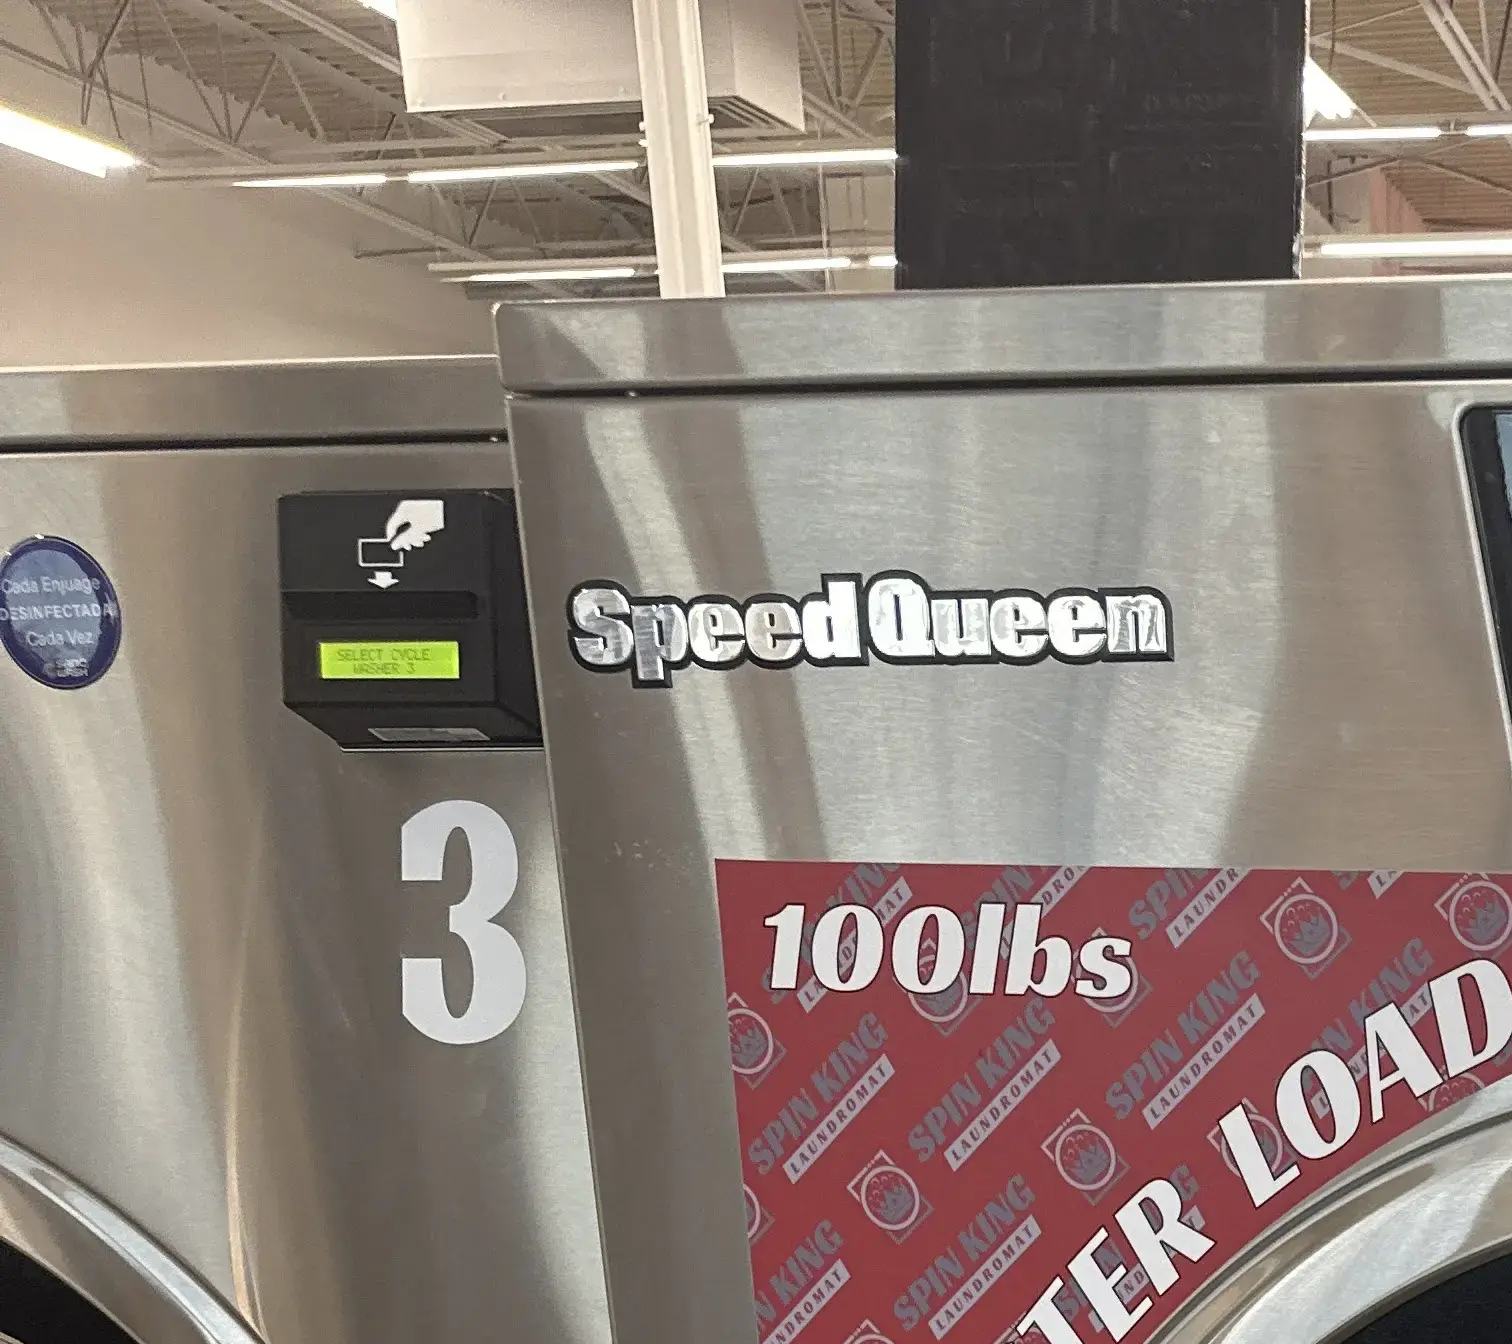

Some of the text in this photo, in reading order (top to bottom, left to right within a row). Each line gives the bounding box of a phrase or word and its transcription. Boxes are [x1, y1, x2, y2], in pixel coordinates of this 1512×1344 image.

[1, 576, 39, 595] Cada
[26, 628, 95, 647] Cada Vez
[337, 648, 431, 661] SELECT CYCLE
[353, 662, 416, 675] WASHER 3
[401, 799, 527, 1045] 3
[763, 902, 1132, 999] 100lbs
[908, 1072, 982, 1163] SPIN
[975, 997, 1055, 1090] KING
[1106, 1028, 1183, 1121] SPIN
[1177, 950, 1260, 1045] KING
[1149, 1003, 1256, 1120] LAUNDROMAT
[748, 1087, 819, 1175] SPIN
[810, 1012, 888, 1104] KING
[790, 1063, 888, 1175] LAUNDROMAT
[951, 1050, 1053, 1162] LAUNDROMAT
[769, 1218, 844, 1306] KING
[893, 1173, 1036, 1332] SPIN KING
[935, 1224, 1034, 1332] LAUNDROMAT
